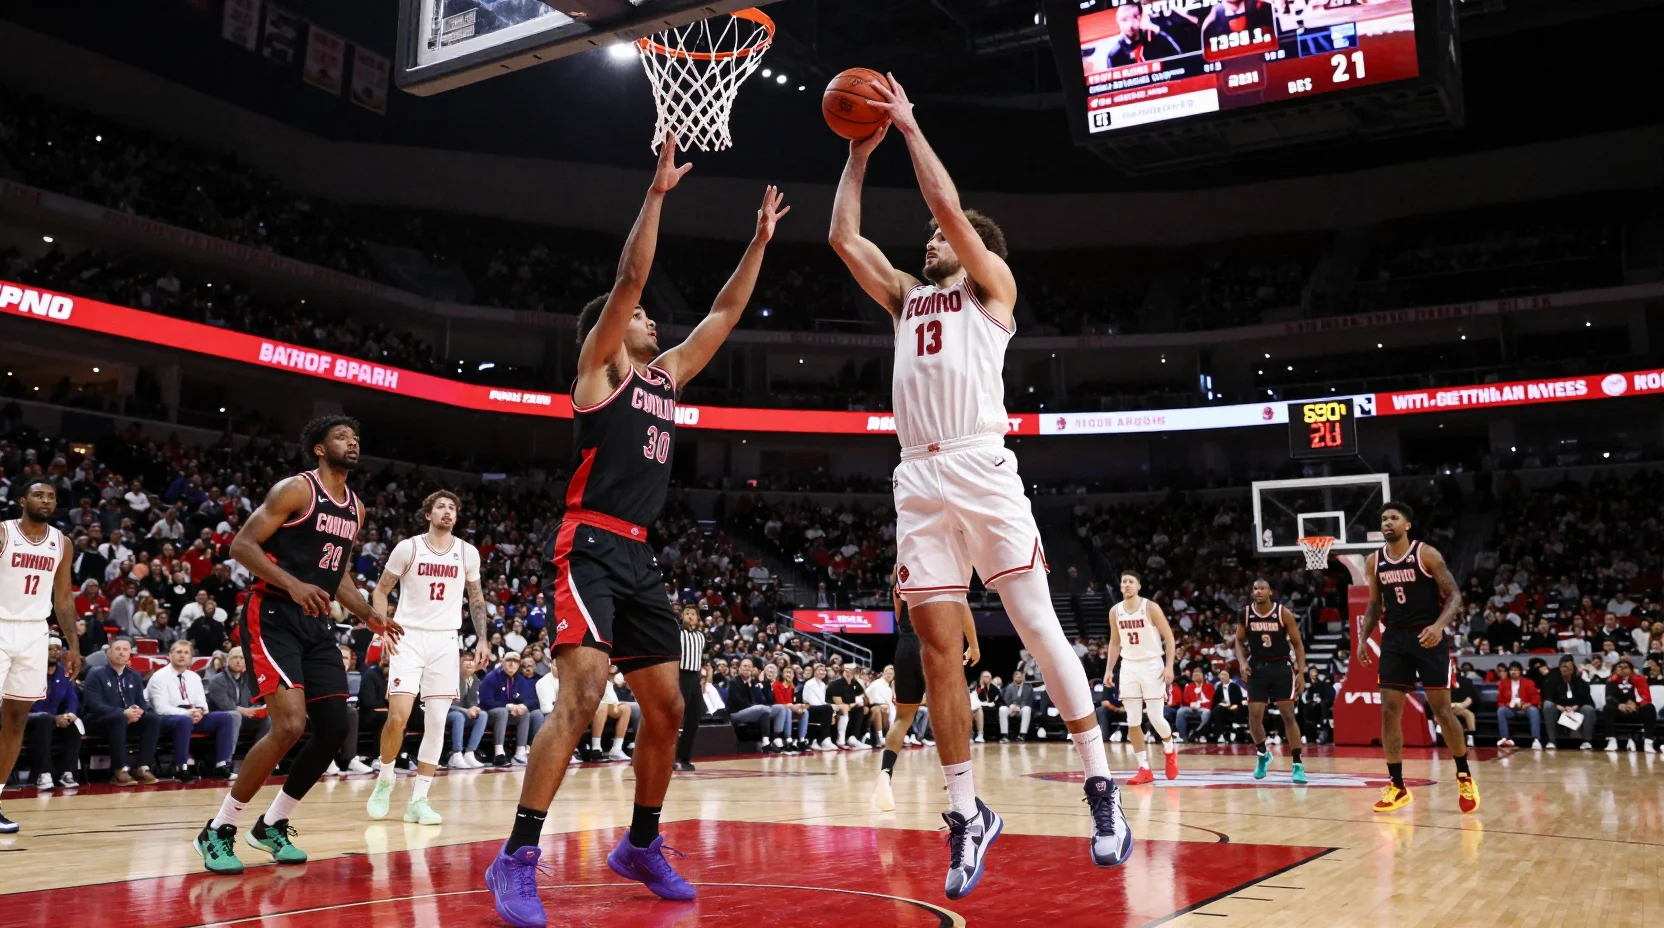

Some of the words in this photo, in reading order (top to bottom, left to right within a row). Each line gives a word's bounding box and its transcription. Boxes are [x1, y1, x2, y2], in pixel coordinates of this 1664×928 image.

[1330, 51, 1366, 84] 21
[915, 319, 943, 357] 13
[643, 425, 671, 464] 30
